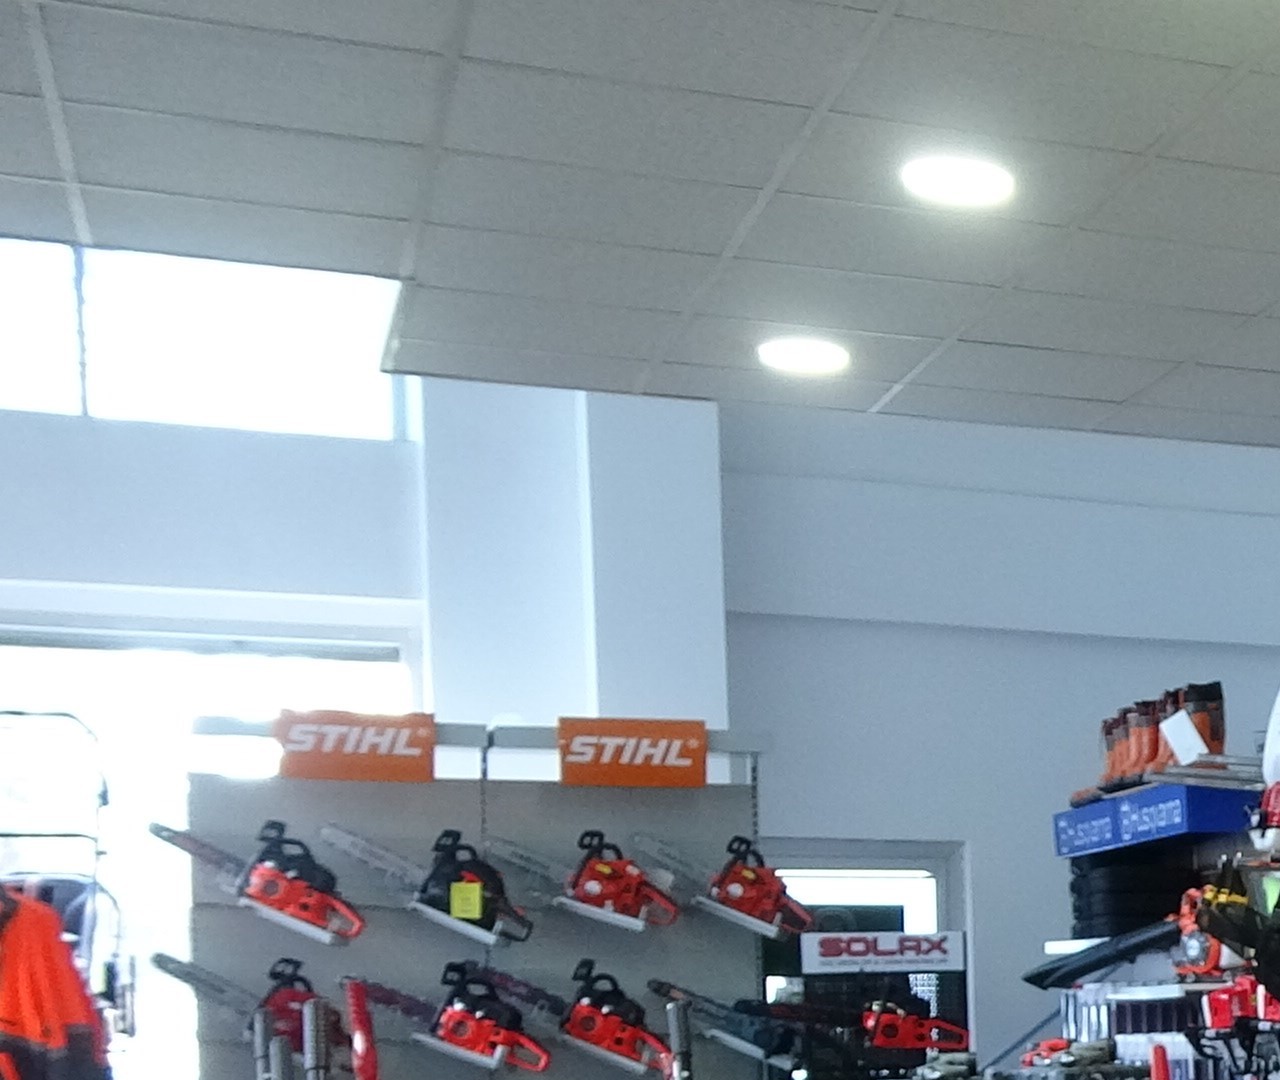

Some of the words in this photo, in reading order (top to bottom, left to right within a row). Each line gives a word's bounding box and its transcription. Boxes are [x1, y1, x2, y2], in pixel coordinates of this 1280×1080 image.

[285, 722, 424, 757] STIHL
[564, 734, 694, 767] STIHL
[819, 935, 948, 957] SOLAX
